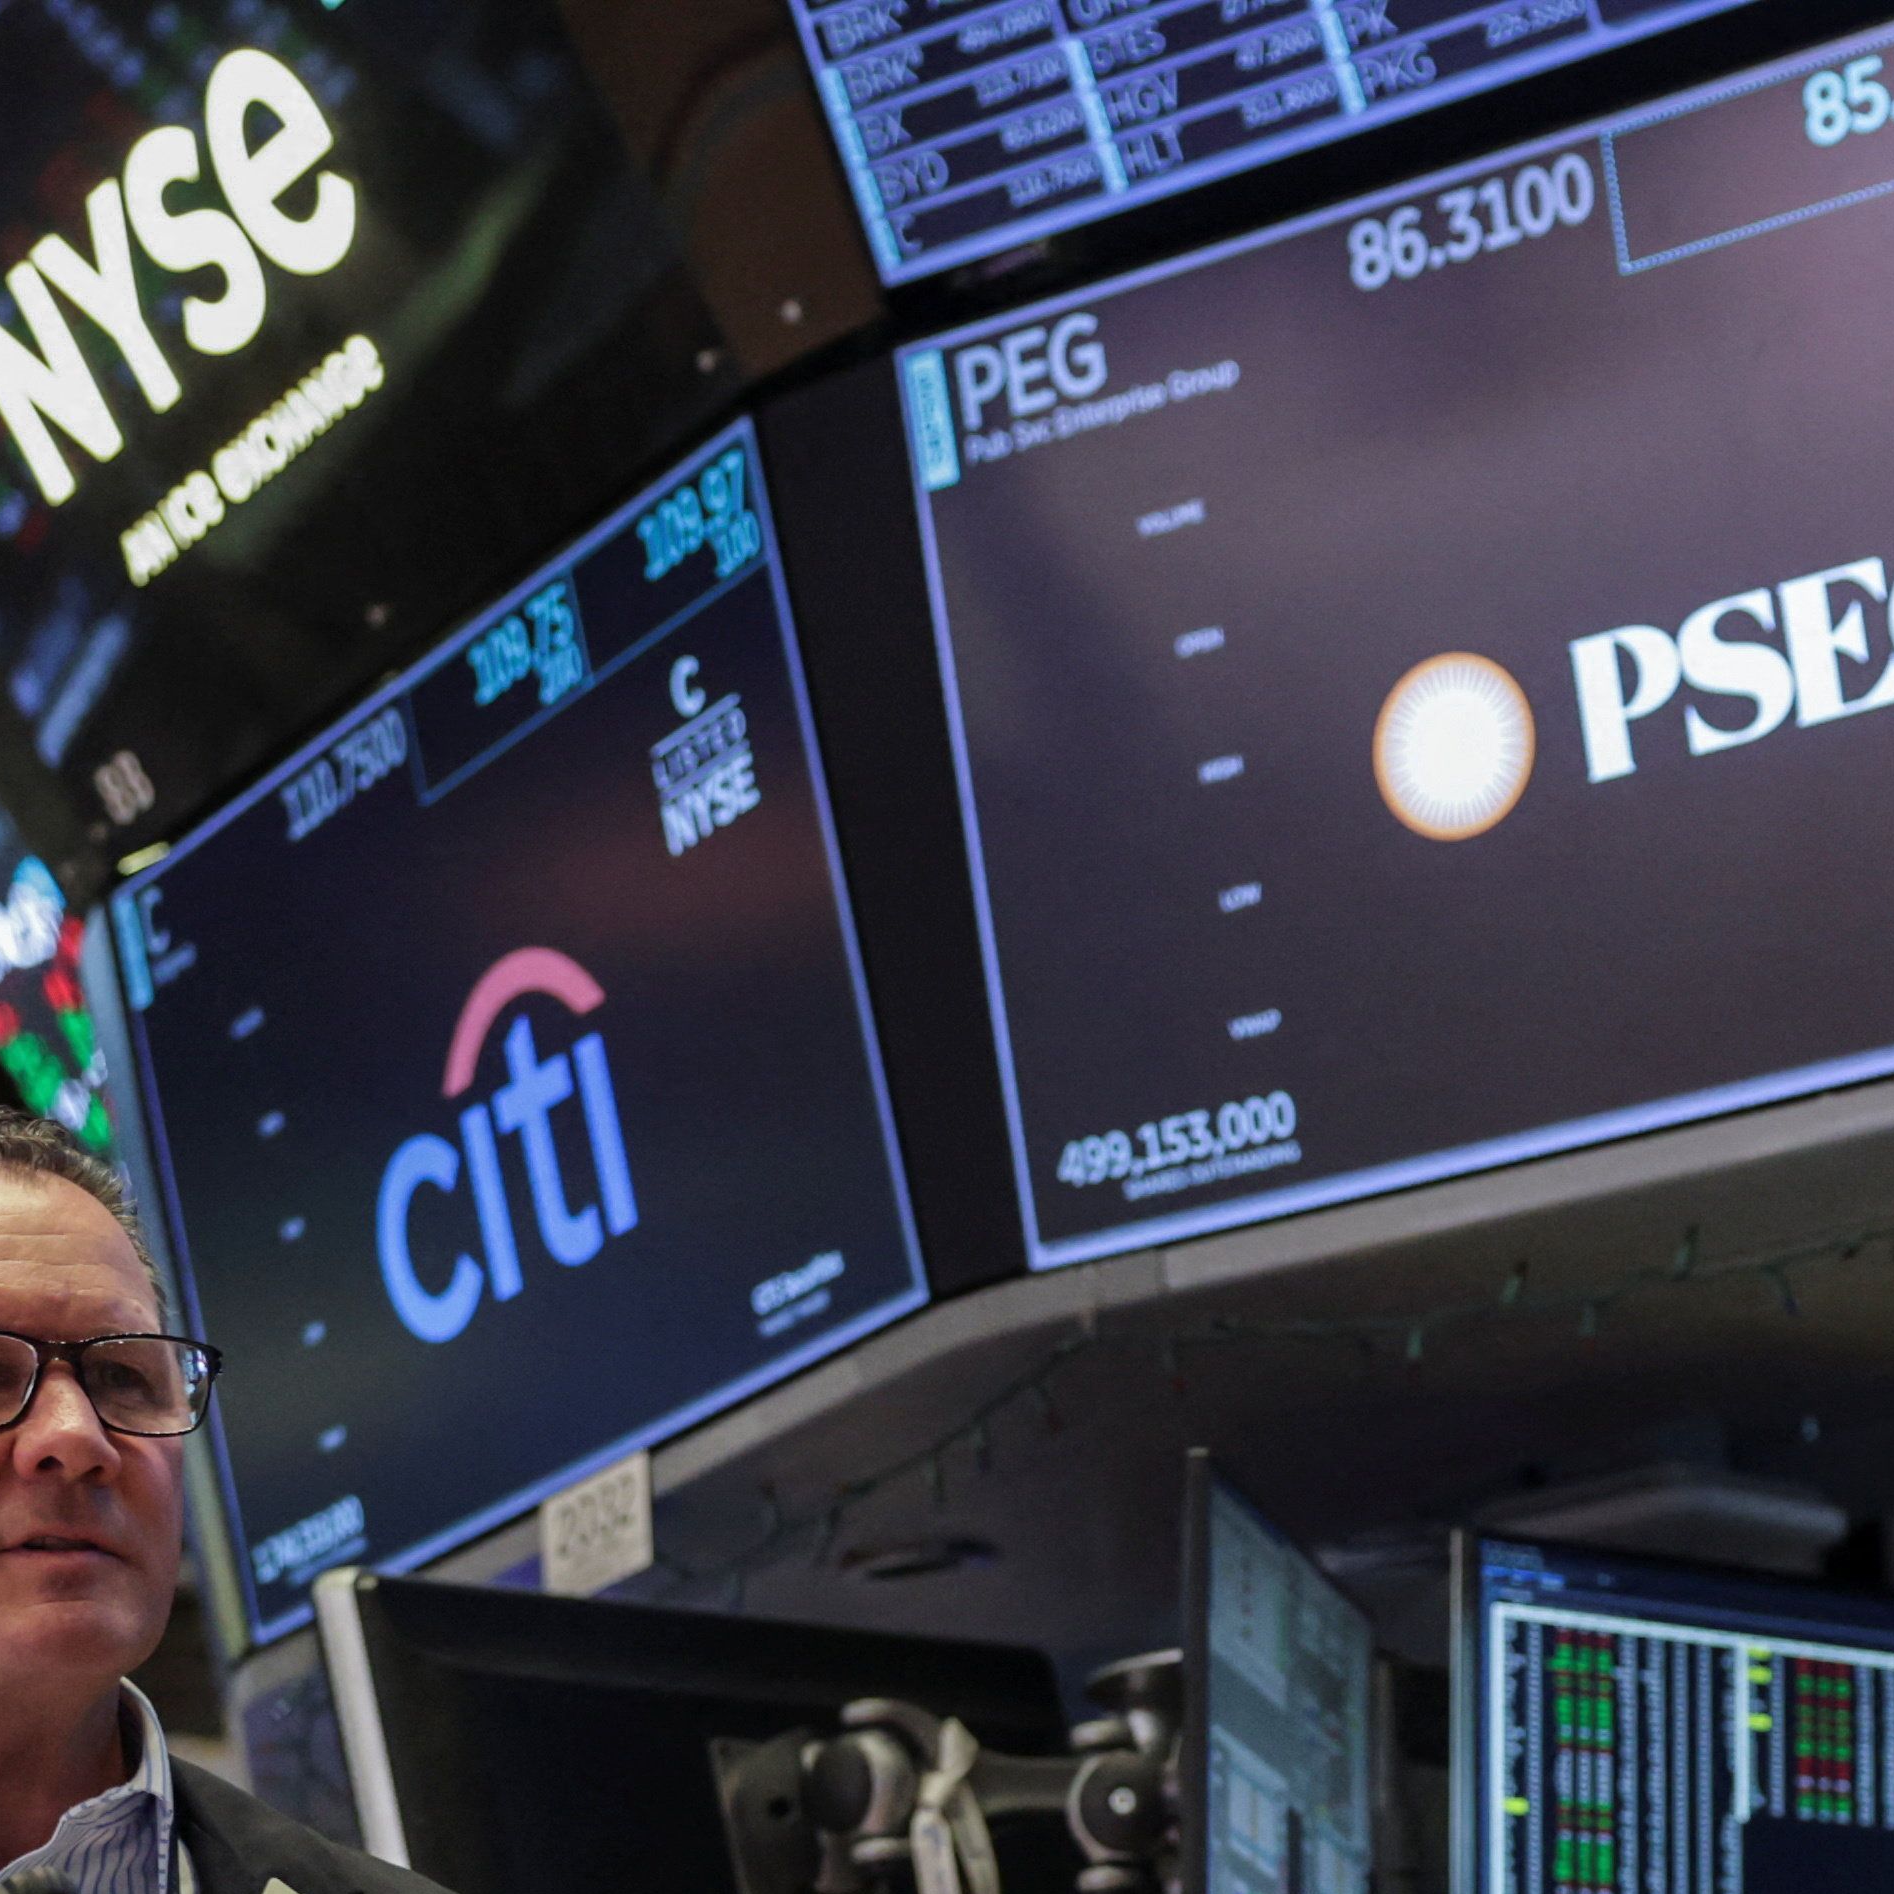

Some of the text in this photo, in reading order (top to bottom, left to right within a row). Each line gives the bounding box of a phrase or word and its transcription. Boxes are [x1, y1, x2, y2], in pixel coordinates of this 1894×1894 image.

[1347, 153, 1594, 291] 86.3100
[955, 312, 1107, 430] PEG
[669, 653, 706, 718] C
[660, 750, 761, 856] NYSE
[375, 1014, 638, 1345] citi
